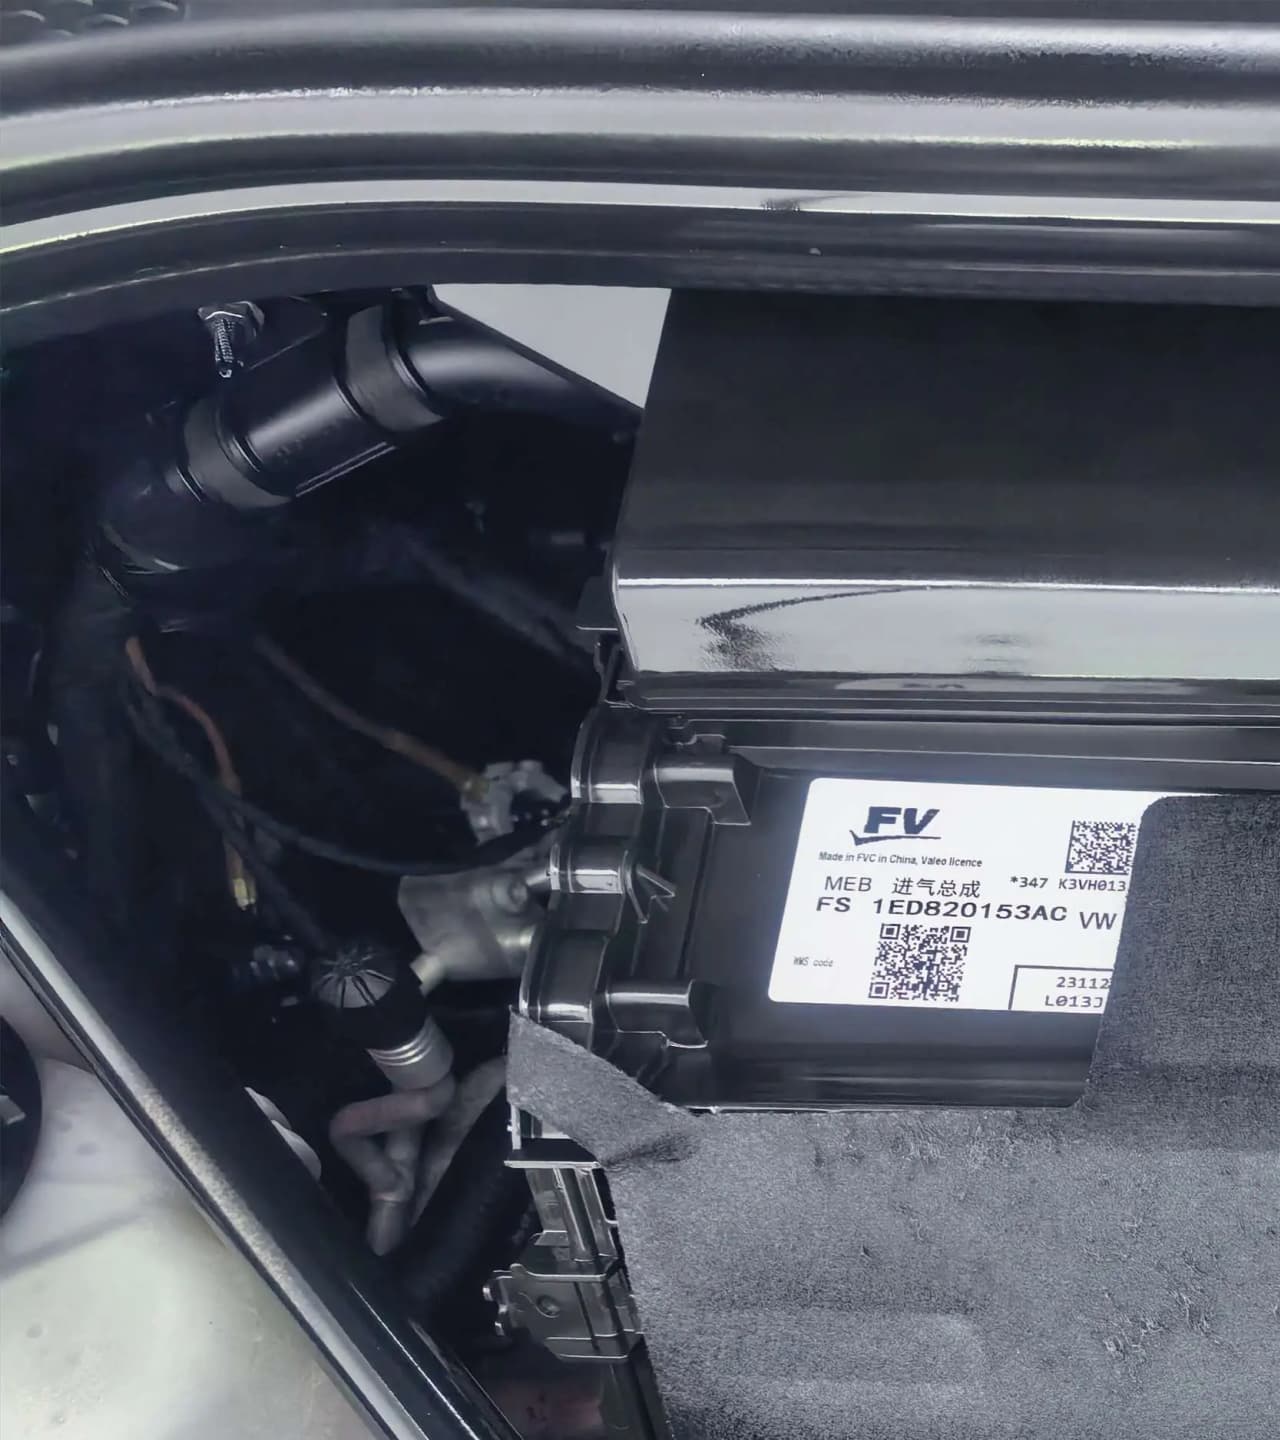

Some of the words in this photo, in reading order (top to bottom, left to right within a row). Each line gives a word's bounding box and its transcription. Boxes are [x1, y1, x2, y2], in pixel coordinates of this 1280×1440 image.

[864, 806, 940, 834] FV
[818, 851, 843, 863] Made
[845, 853, 855, 863] in
[857, 853, 877, 863] FVC
[878, 854, 888, 863] in
[889, 854, 918, 866] China,
[921, 856, 947, 866] Valeo
[949, 856, 983, 867] licence
[824, 876, 872, 892] MEB
[891, 876, 982, 898] 进气总成
[816, 896, 851, 912] FS
[873, 898, 1068, 922] 1ED820153AC
[1079, 911, 1118, 930] VW
